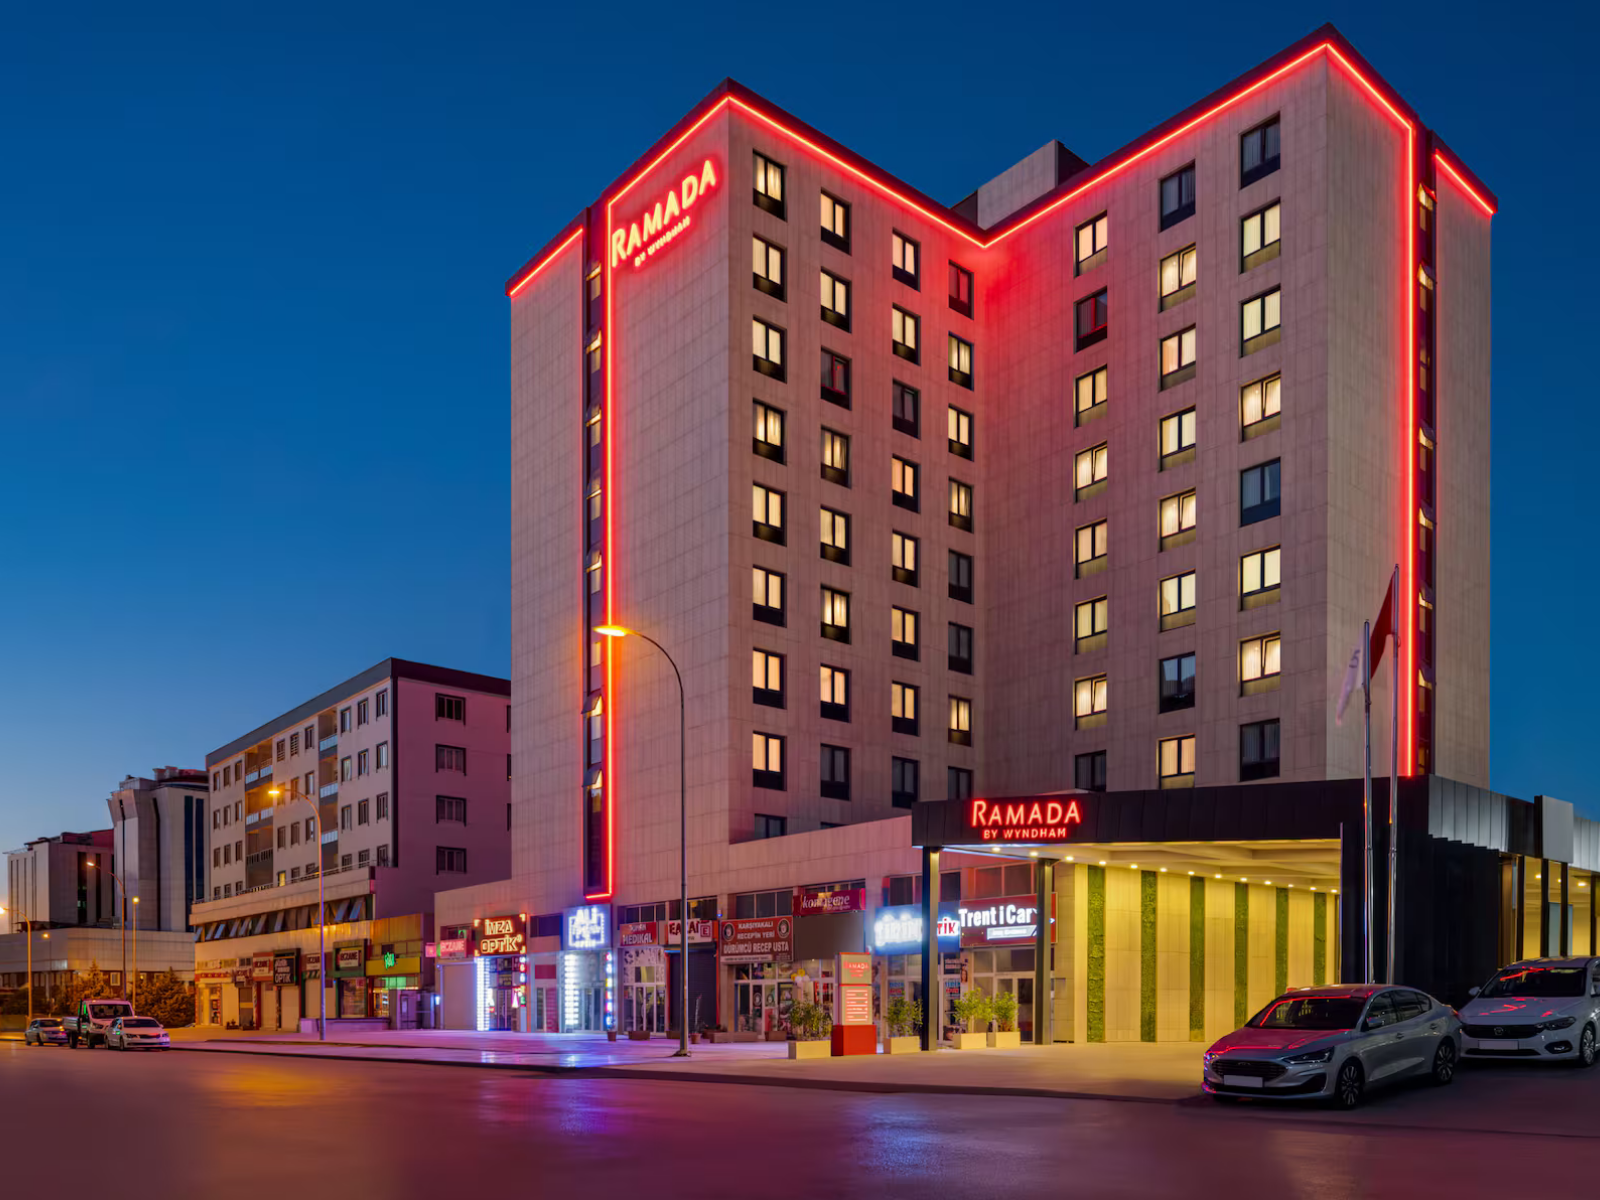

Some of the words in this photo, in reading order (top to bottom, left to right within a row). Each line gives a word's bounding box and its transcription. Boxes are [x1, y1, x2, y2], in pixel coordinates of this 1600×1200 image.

[612, 160, 717, 267] RAMADA
[634, 252, 646, 267] BY
[647, 215, 690, 255] WYNDHAM
[972, 800, 1081, 827] RAMADA
[983, 829, 998, 839] BY
[1003, 827, 1067, 839] WYNDHAM
[958, 907, 997, 927] Trent
[1006, 904, 1034, 924] Car
[484, 919, 513, 936] İMZA
[481, 935, 519, 954] OPTİK
[753, 942, 772, 953] RECEP
[773, 941, 789, 952] USTA
